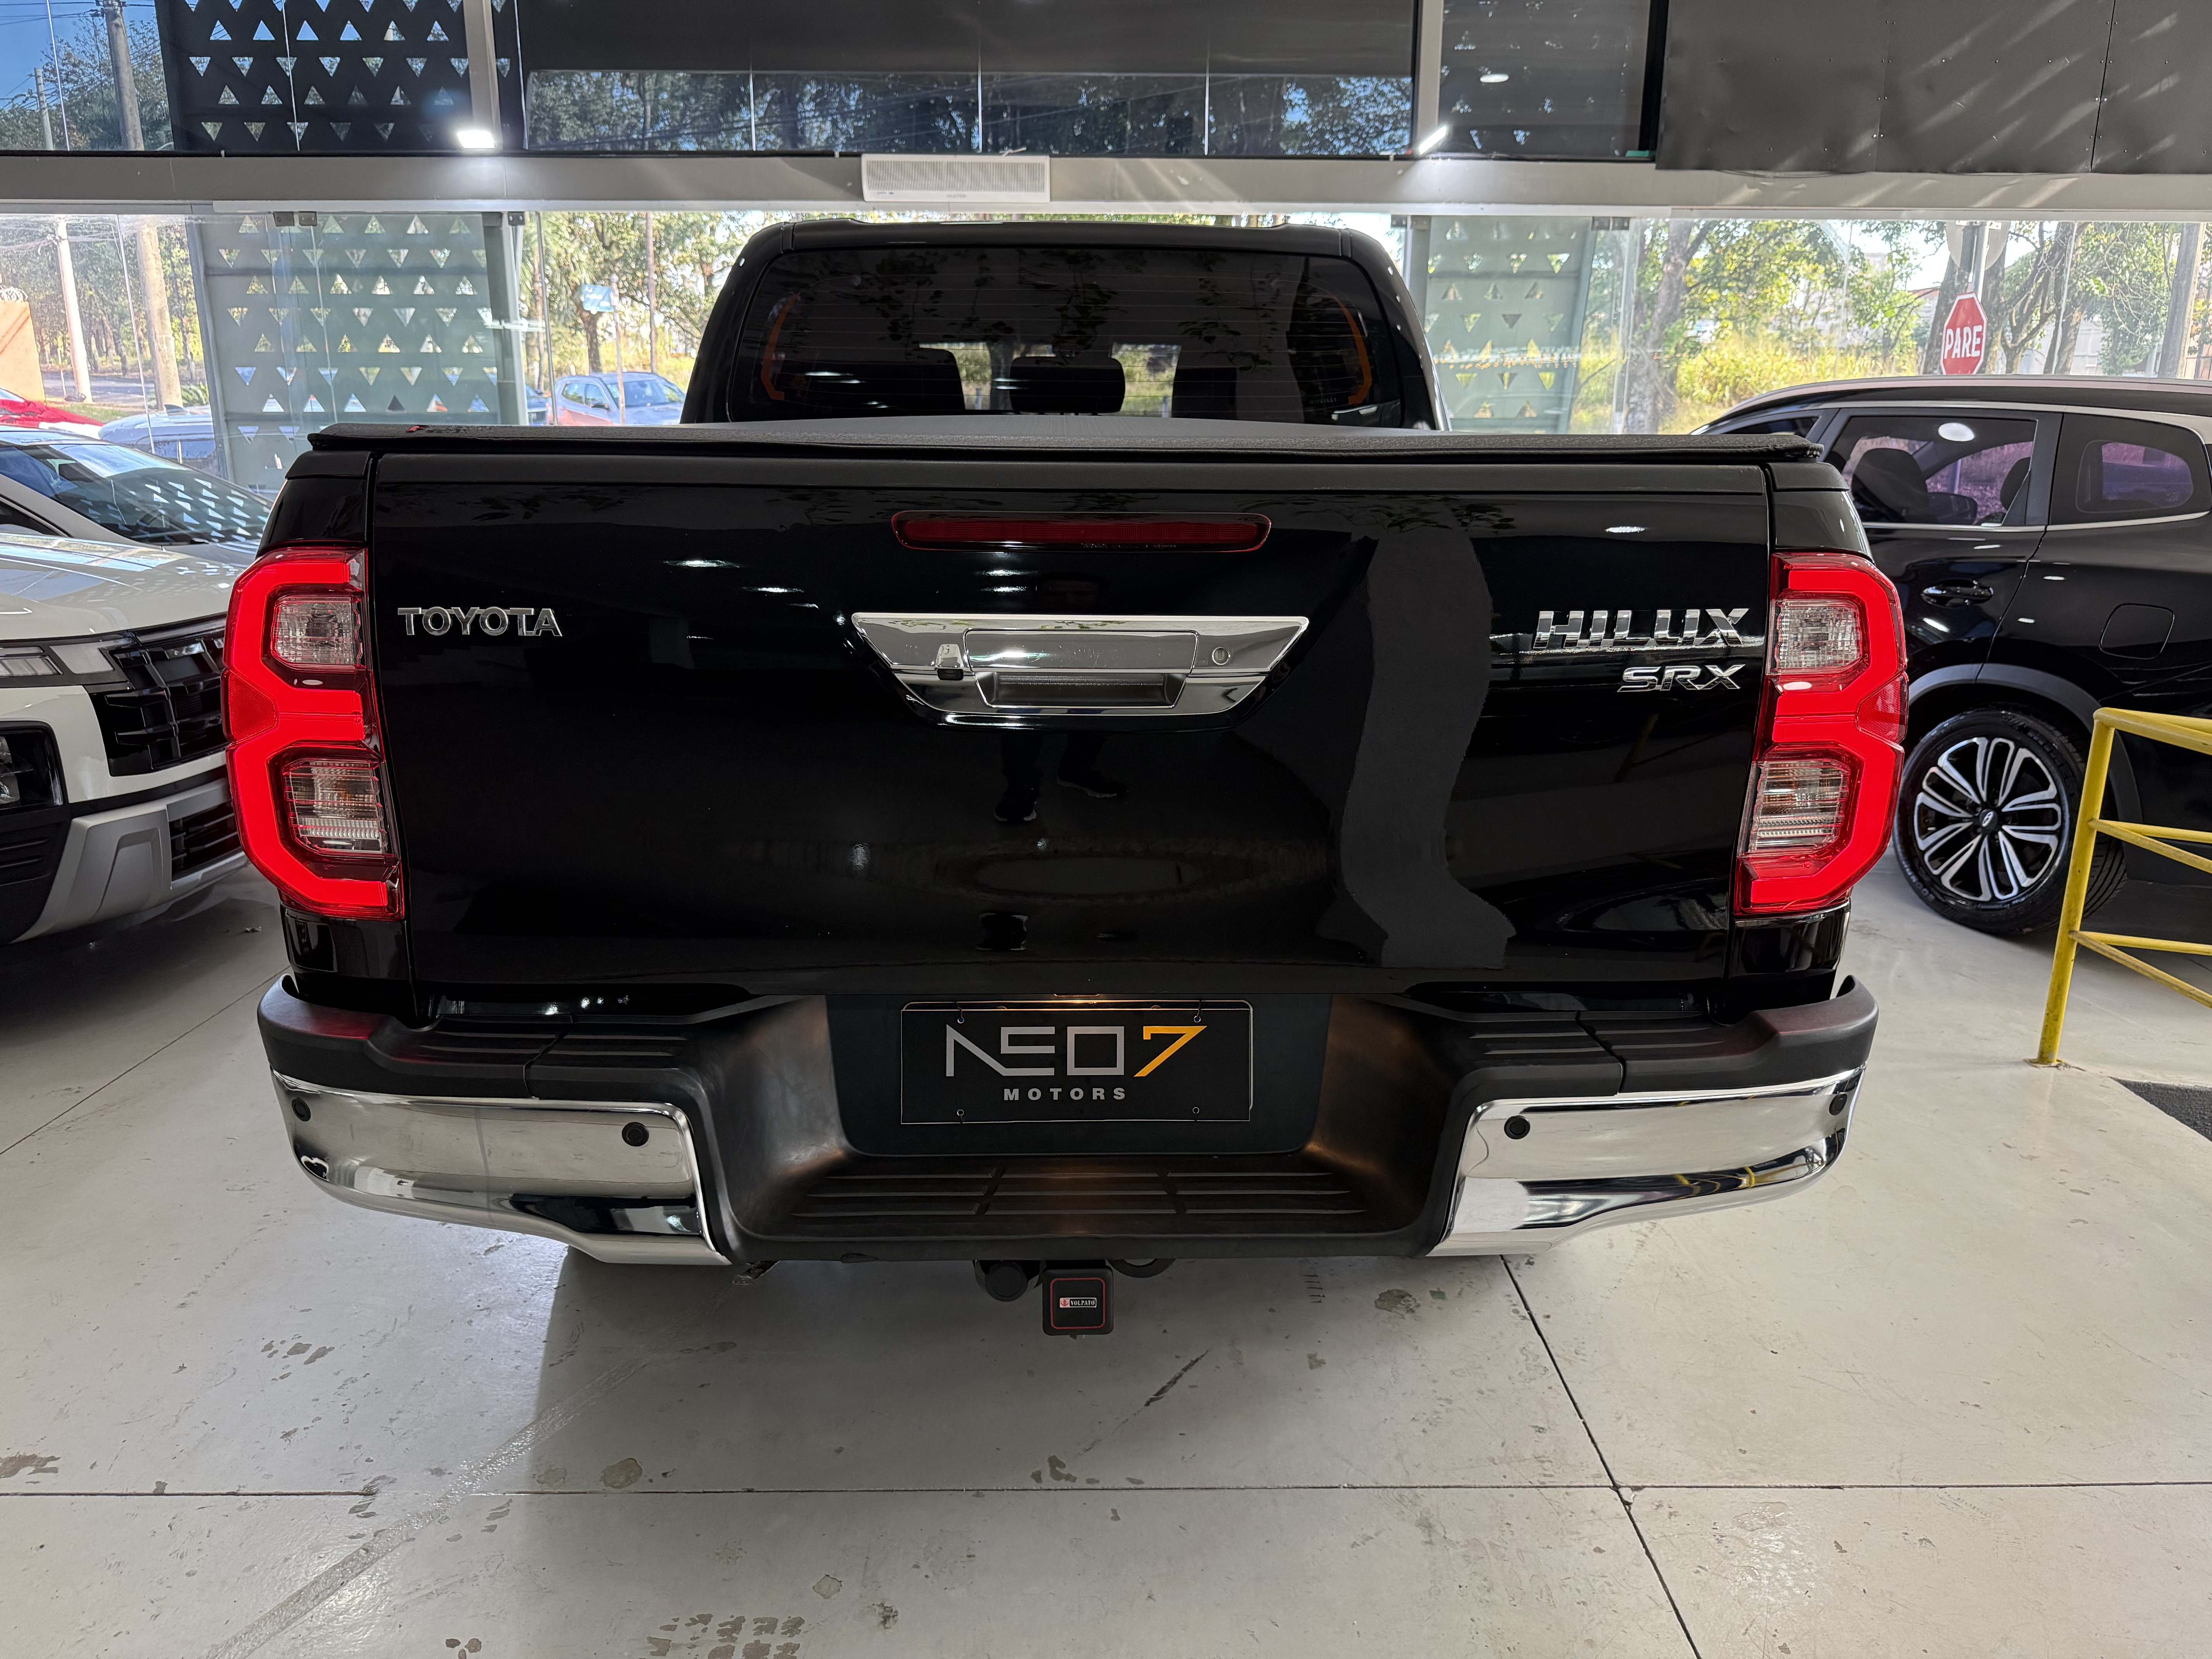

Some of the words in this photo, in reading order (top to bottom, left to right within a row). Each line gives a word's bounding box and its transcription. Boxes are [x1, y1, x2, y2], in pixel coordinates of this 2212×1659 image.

[1944, 325, 1982, 359] PARE
[398, 606, 563, 637] TOYOTA
[1533, 608, 1749, 649] HILUX
[1617, 664, 1746, 692] SRX
[1004, 1088, 1125, 1101] MOTORS
